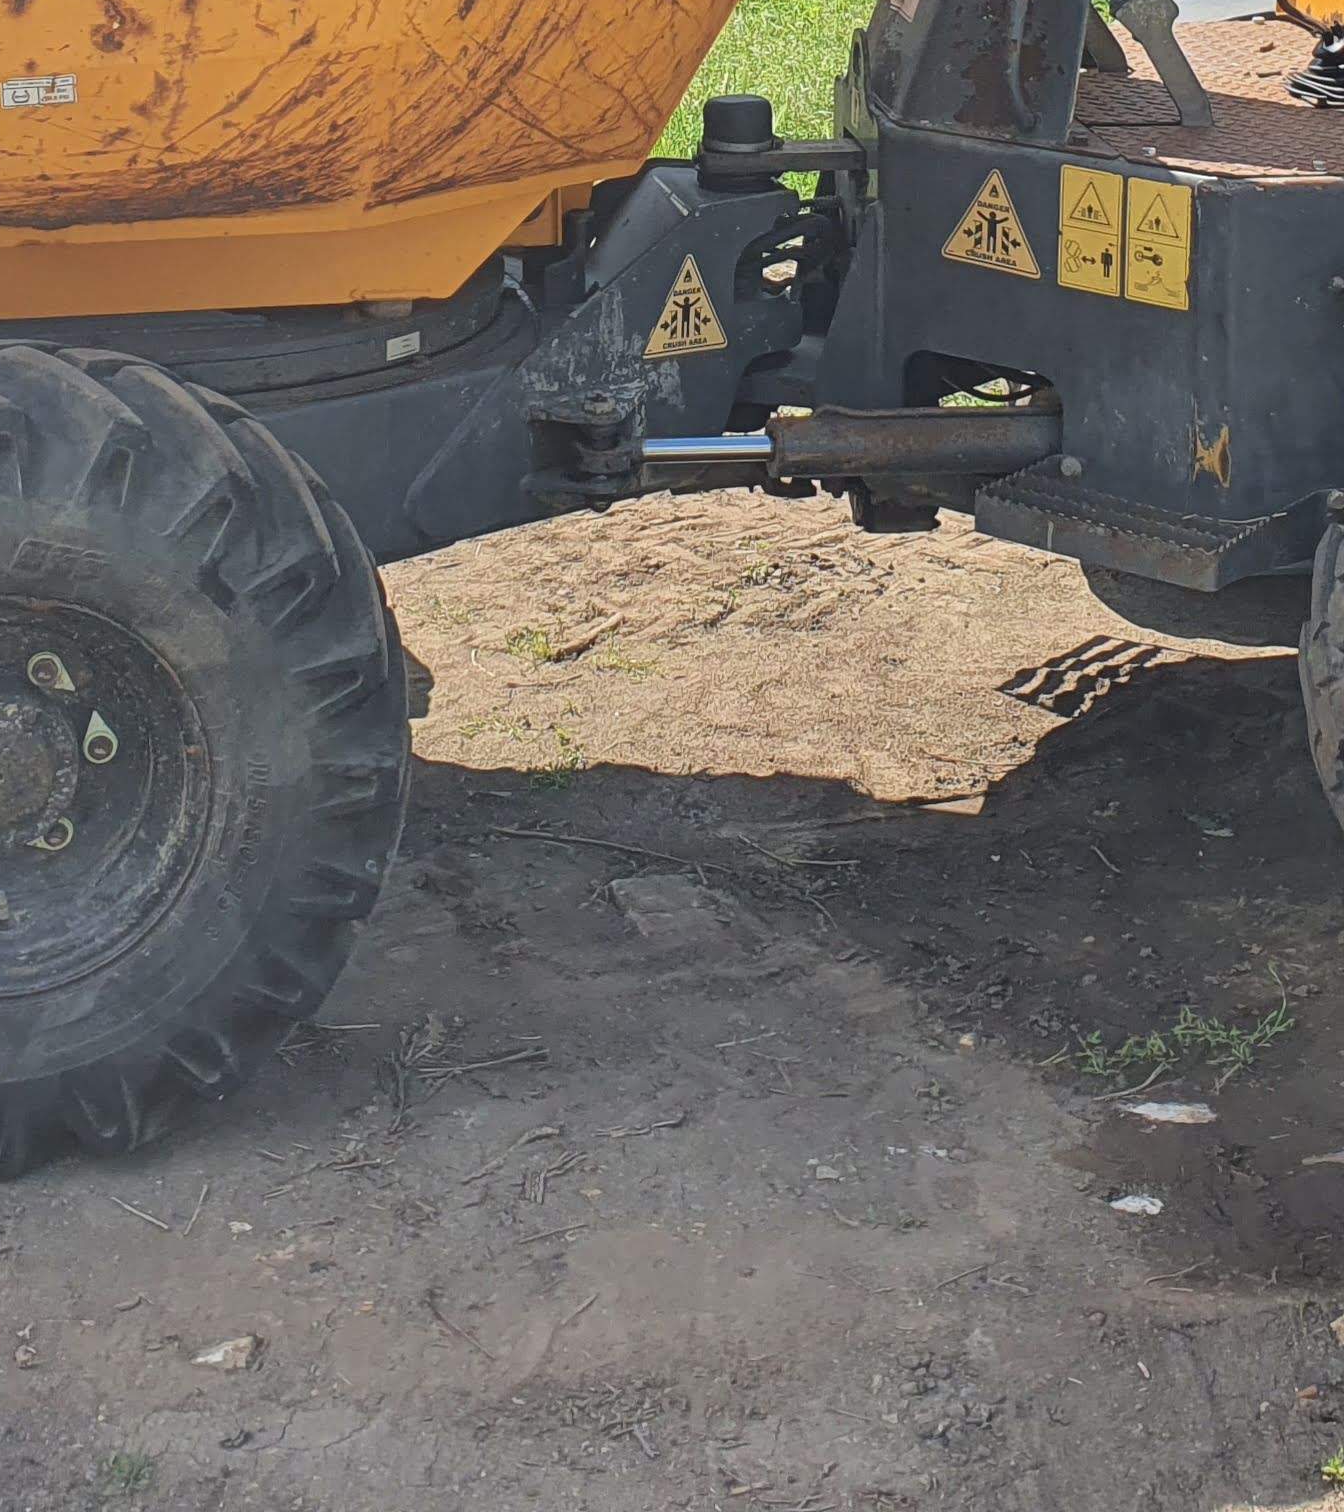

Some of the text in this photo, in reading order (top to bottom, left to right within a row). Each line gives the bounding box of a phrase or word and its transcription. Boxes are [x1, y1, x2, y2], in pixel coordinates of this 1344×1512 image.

[977, 200, 1010, 213] DANGER
[965, 249, 1017, 267] CRUSH AREA
[673, 287, 702, 296] DANGER
[662, 337, 708, 349] CRUSH AREA
